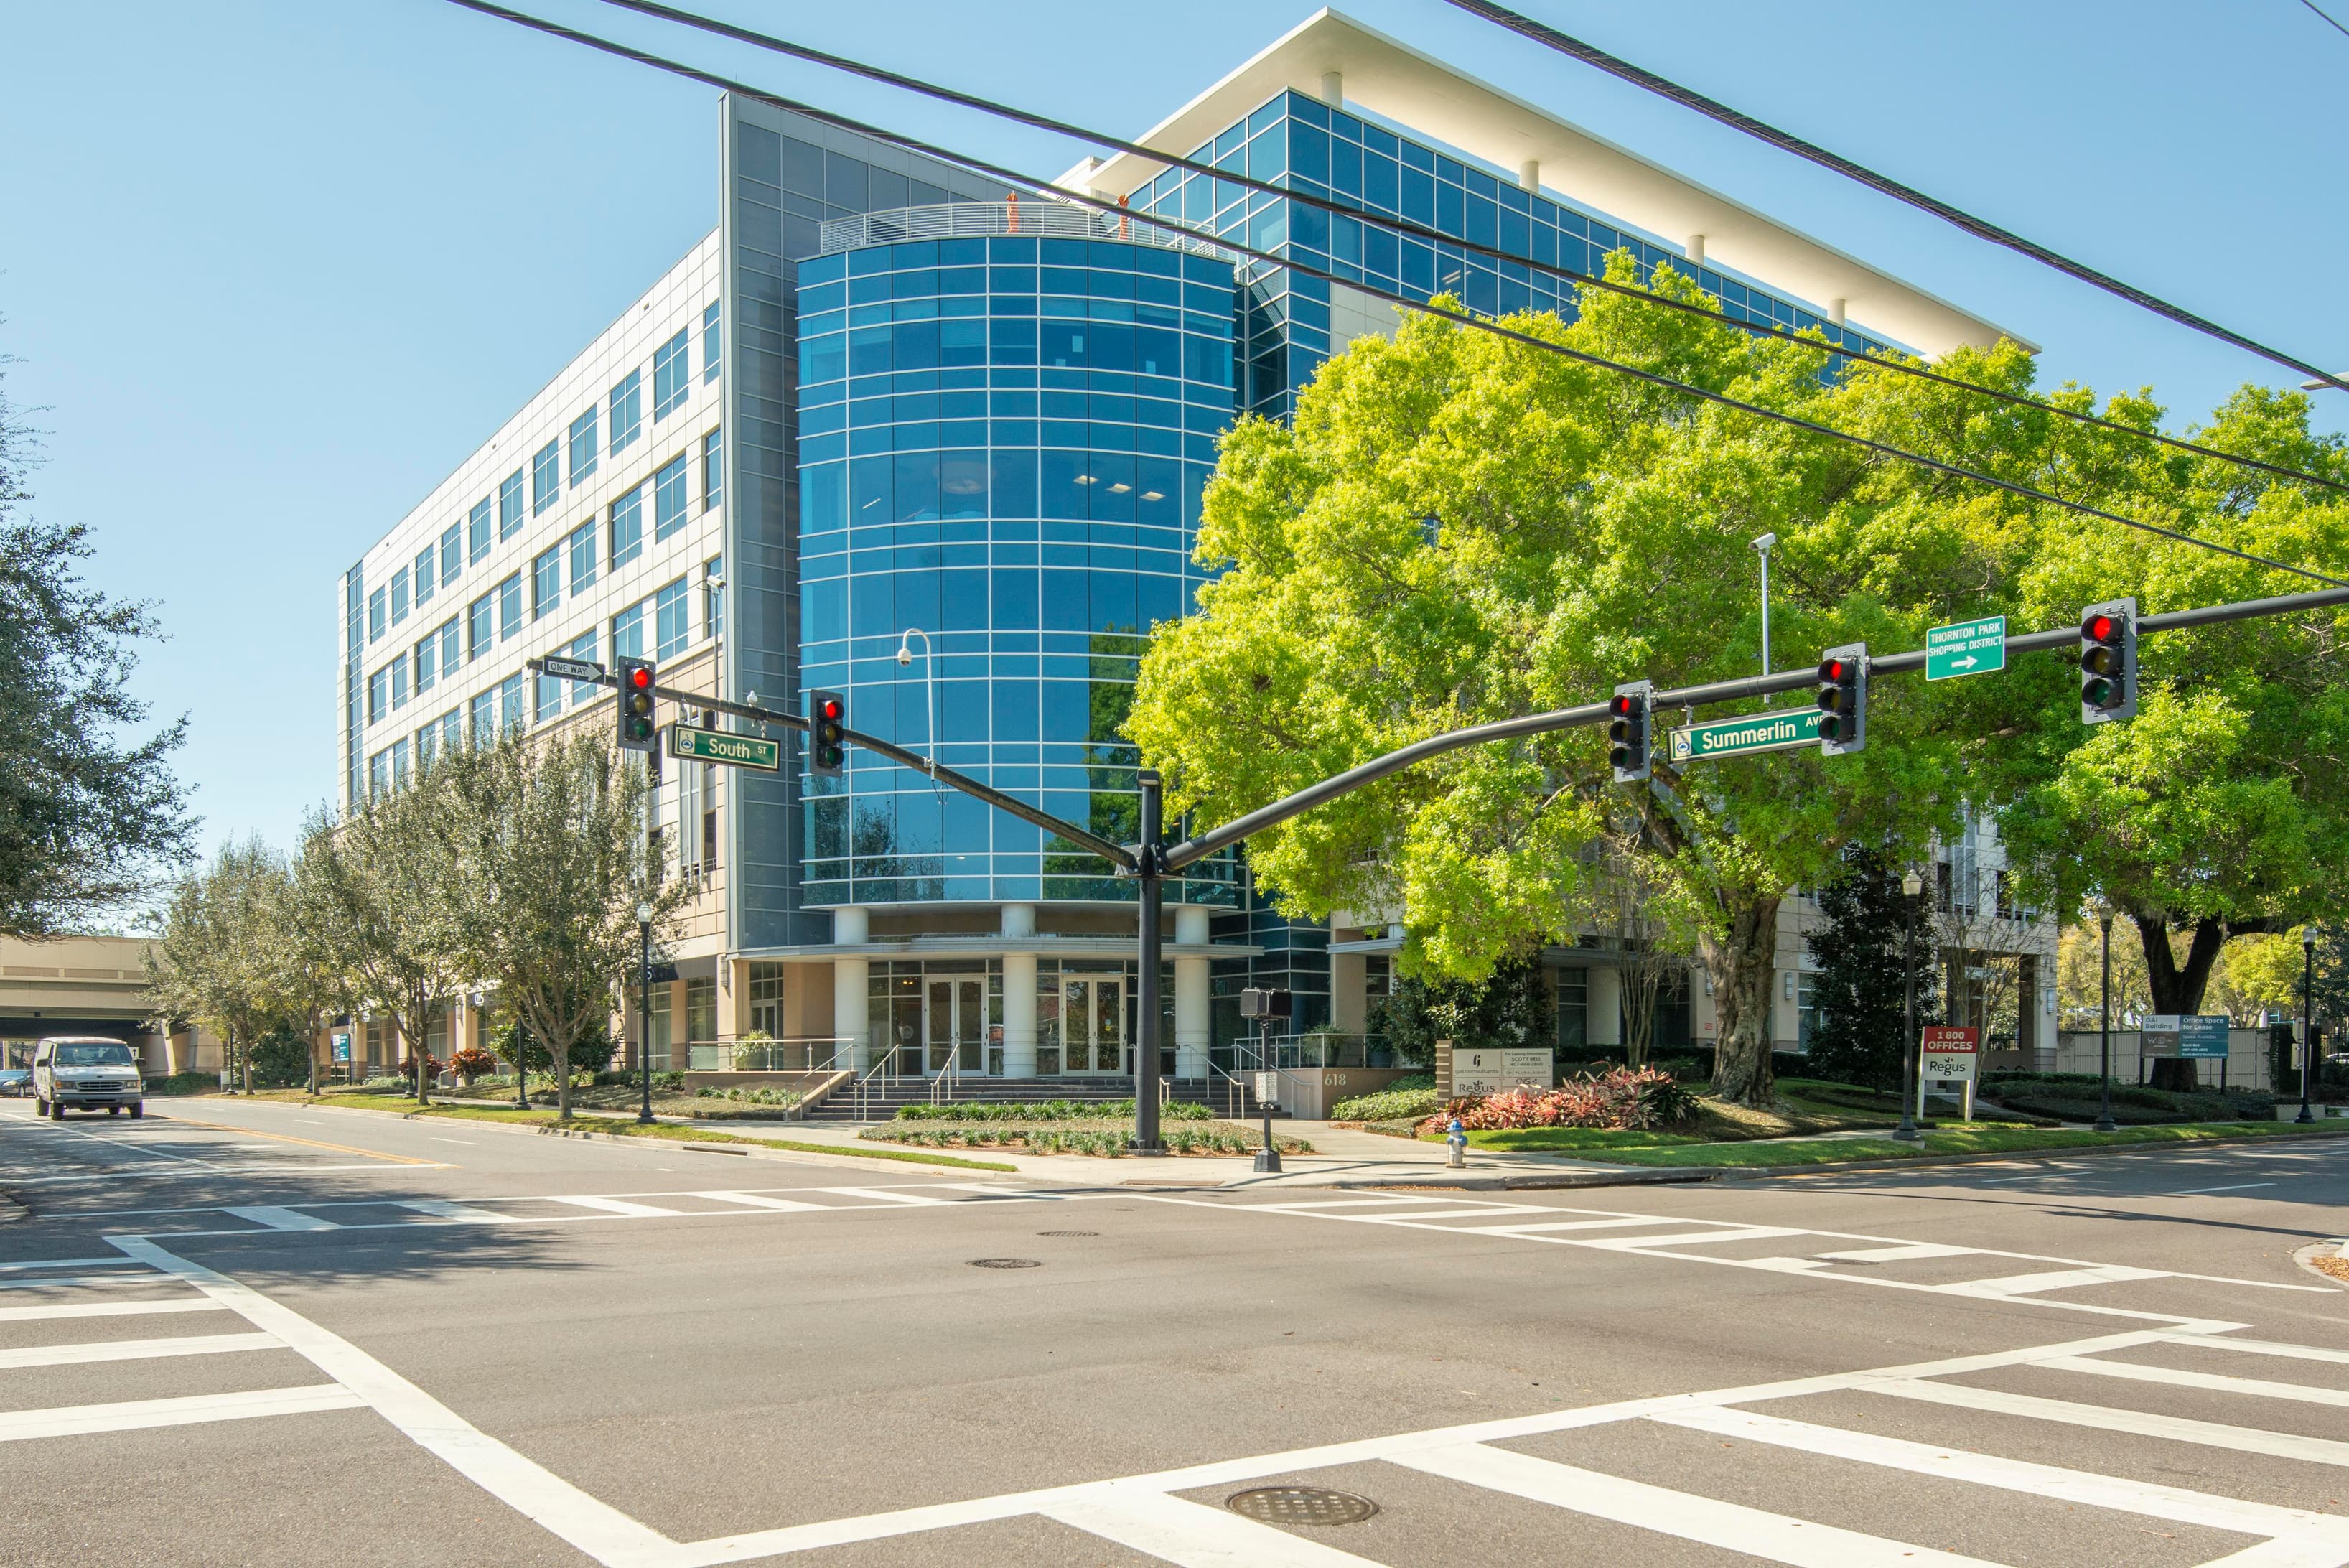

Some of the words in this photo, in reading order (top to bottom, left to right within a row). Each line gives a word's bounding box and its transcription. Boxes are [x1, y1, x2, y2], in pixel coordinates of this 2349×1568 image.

[1930, 627, 1975, 644] THORNTON
[1979, 622, 2001, 635] PARK
[1928, 642, 1966, 657] SHOPPING
[1969, 635, 2002, 650] DISTRICT
[551, 662, 568, 673] ONE
[570, 665, 587, 675] WAY
[1701, 721, 1797, 750] Summerlin
[709, 738, 750, 759] South
[757, 745, 767, 755] ST
[1928, 1041, 1973, 1050] OFFICES
[1930, 1061, 1966, 1076] Regus
[1325, 1073, 1346, 1086] 618
[1459, 1083, 1495, 1096] Regus
